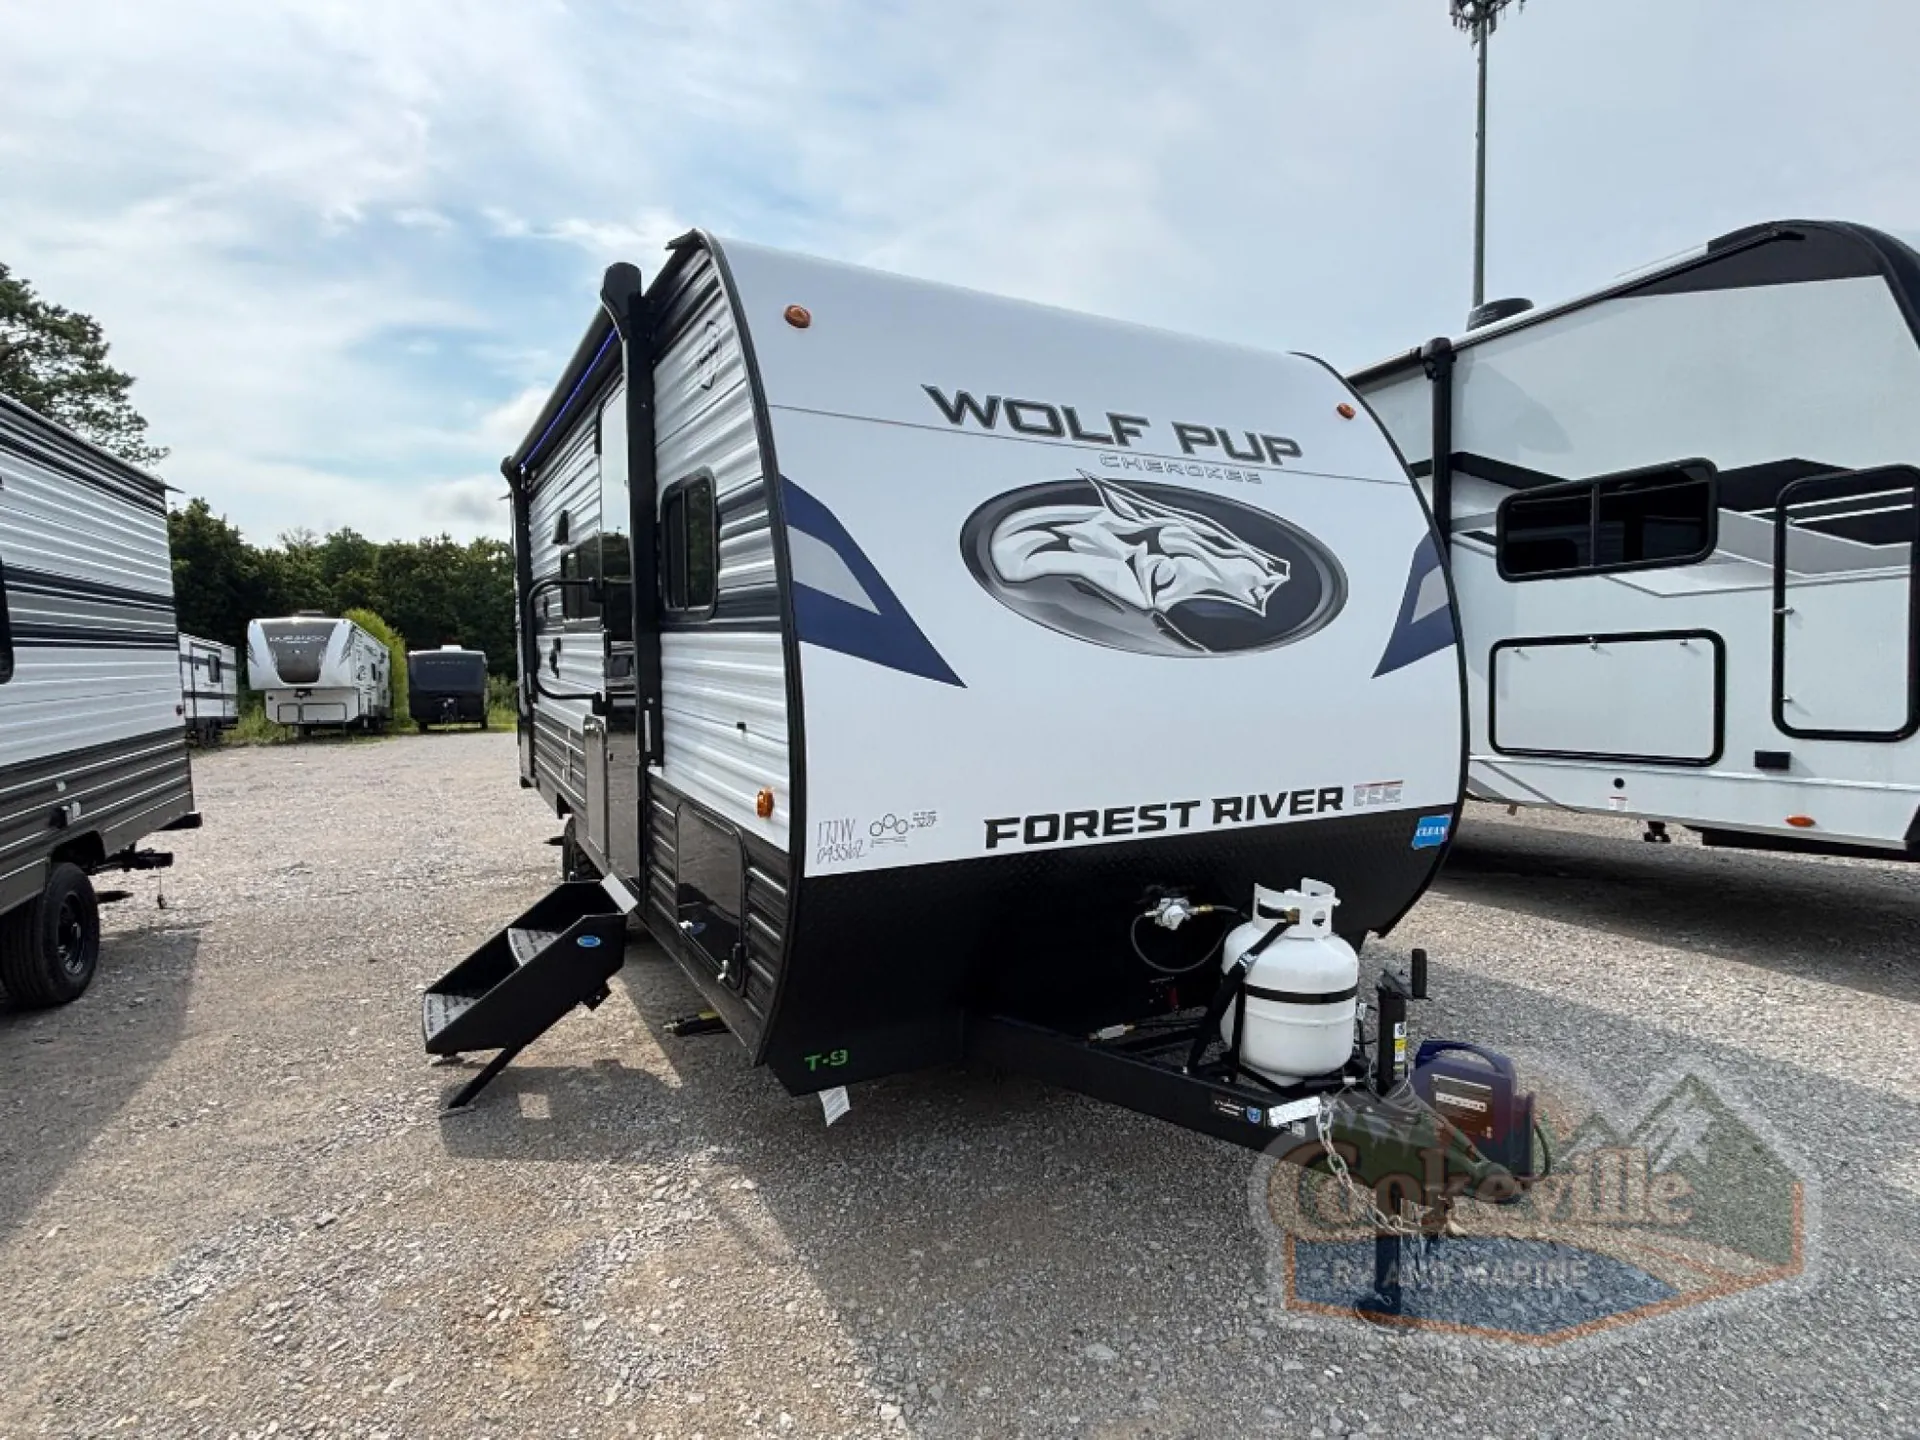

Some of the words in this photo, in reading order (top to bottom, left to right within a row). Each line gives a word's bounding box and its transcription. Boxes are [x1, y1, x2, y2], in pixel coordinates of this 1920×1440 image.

[921, 384, 1149, 448] WOLF
[1171, 421, 1303, 466] PUP
[1099, 455, 1263, 484] CHEROKEE
[983, 799, 1201, 849] FOREST
[1211, 787, 1344, 824] RIVER
[804, 1049, 849, 1072] T-9
